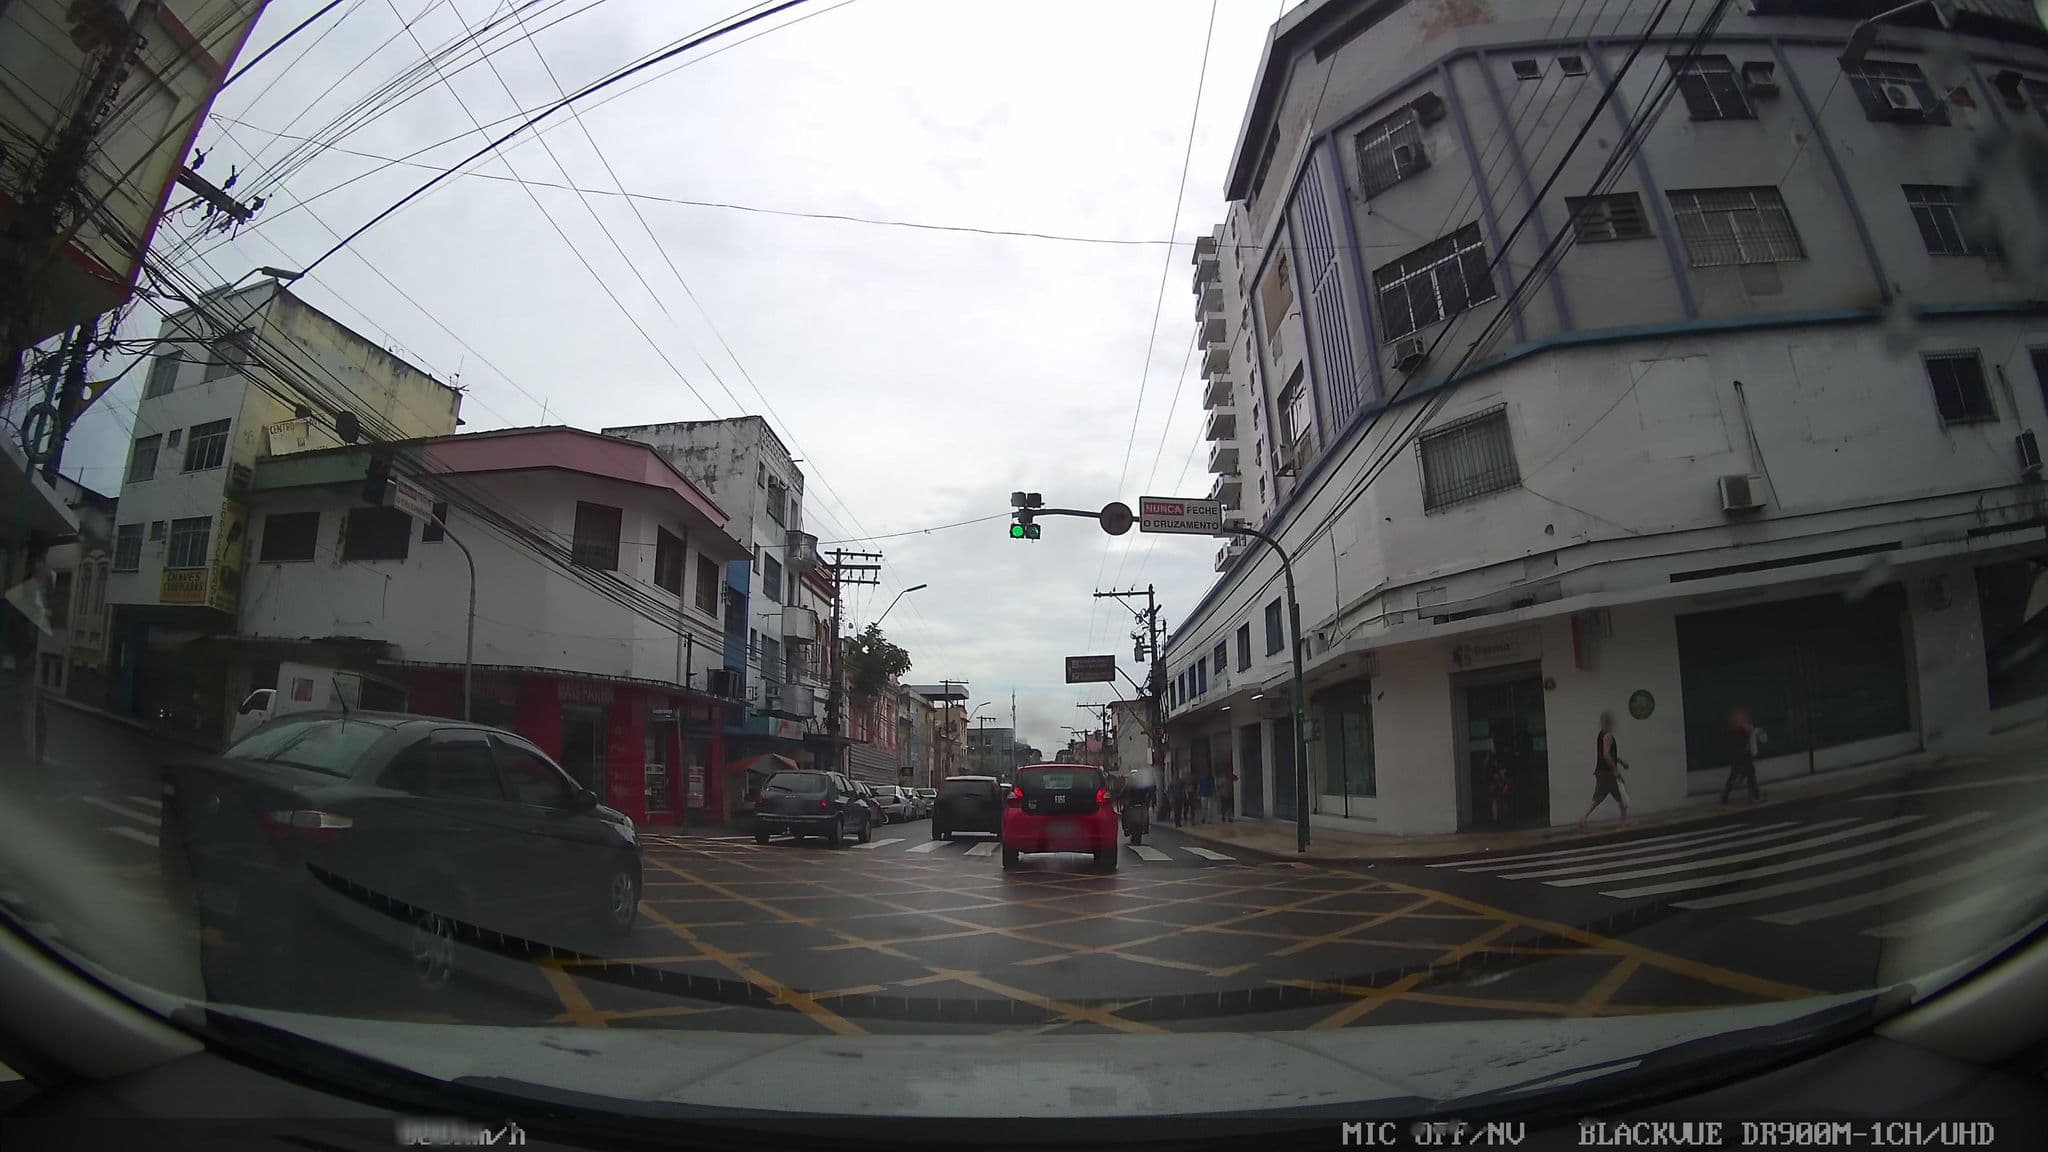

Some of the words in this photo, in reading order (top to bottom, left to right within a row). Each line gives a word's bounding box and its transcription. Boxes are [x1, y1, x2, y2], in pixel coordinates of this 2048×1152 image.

[1145, 503, 1182, 514] NUNCA
[1187, 506, 1218, 515] FECHE
[1143, 519, 1152, 528] O
[1154, 520, 1219, 530] CRUZAMENTO
